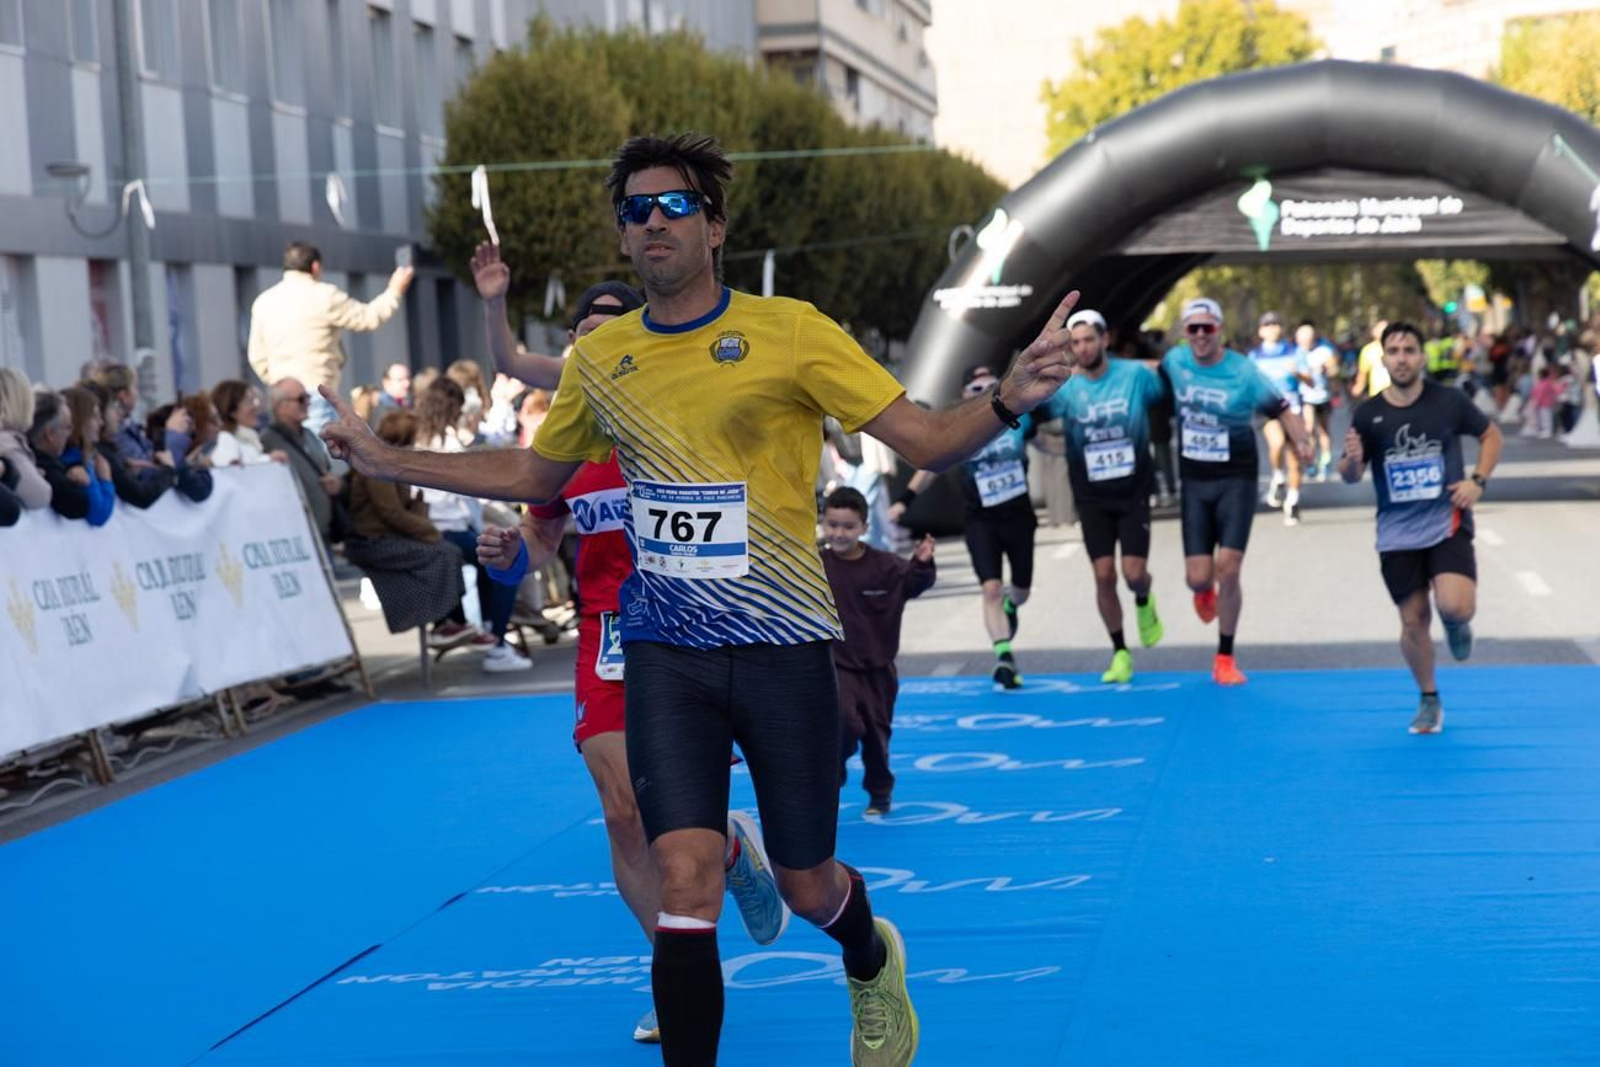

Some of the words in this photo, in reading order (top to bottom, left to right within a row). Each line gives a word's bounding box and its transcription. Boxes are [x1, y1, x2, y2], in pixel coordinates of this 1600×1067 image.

[1392, 466, 1441, 487] 2356
[648, 508, 722, 543] 767
[669, 544, 698, 553] CARLOS
[427, 975, 644, 991] MEDIA
